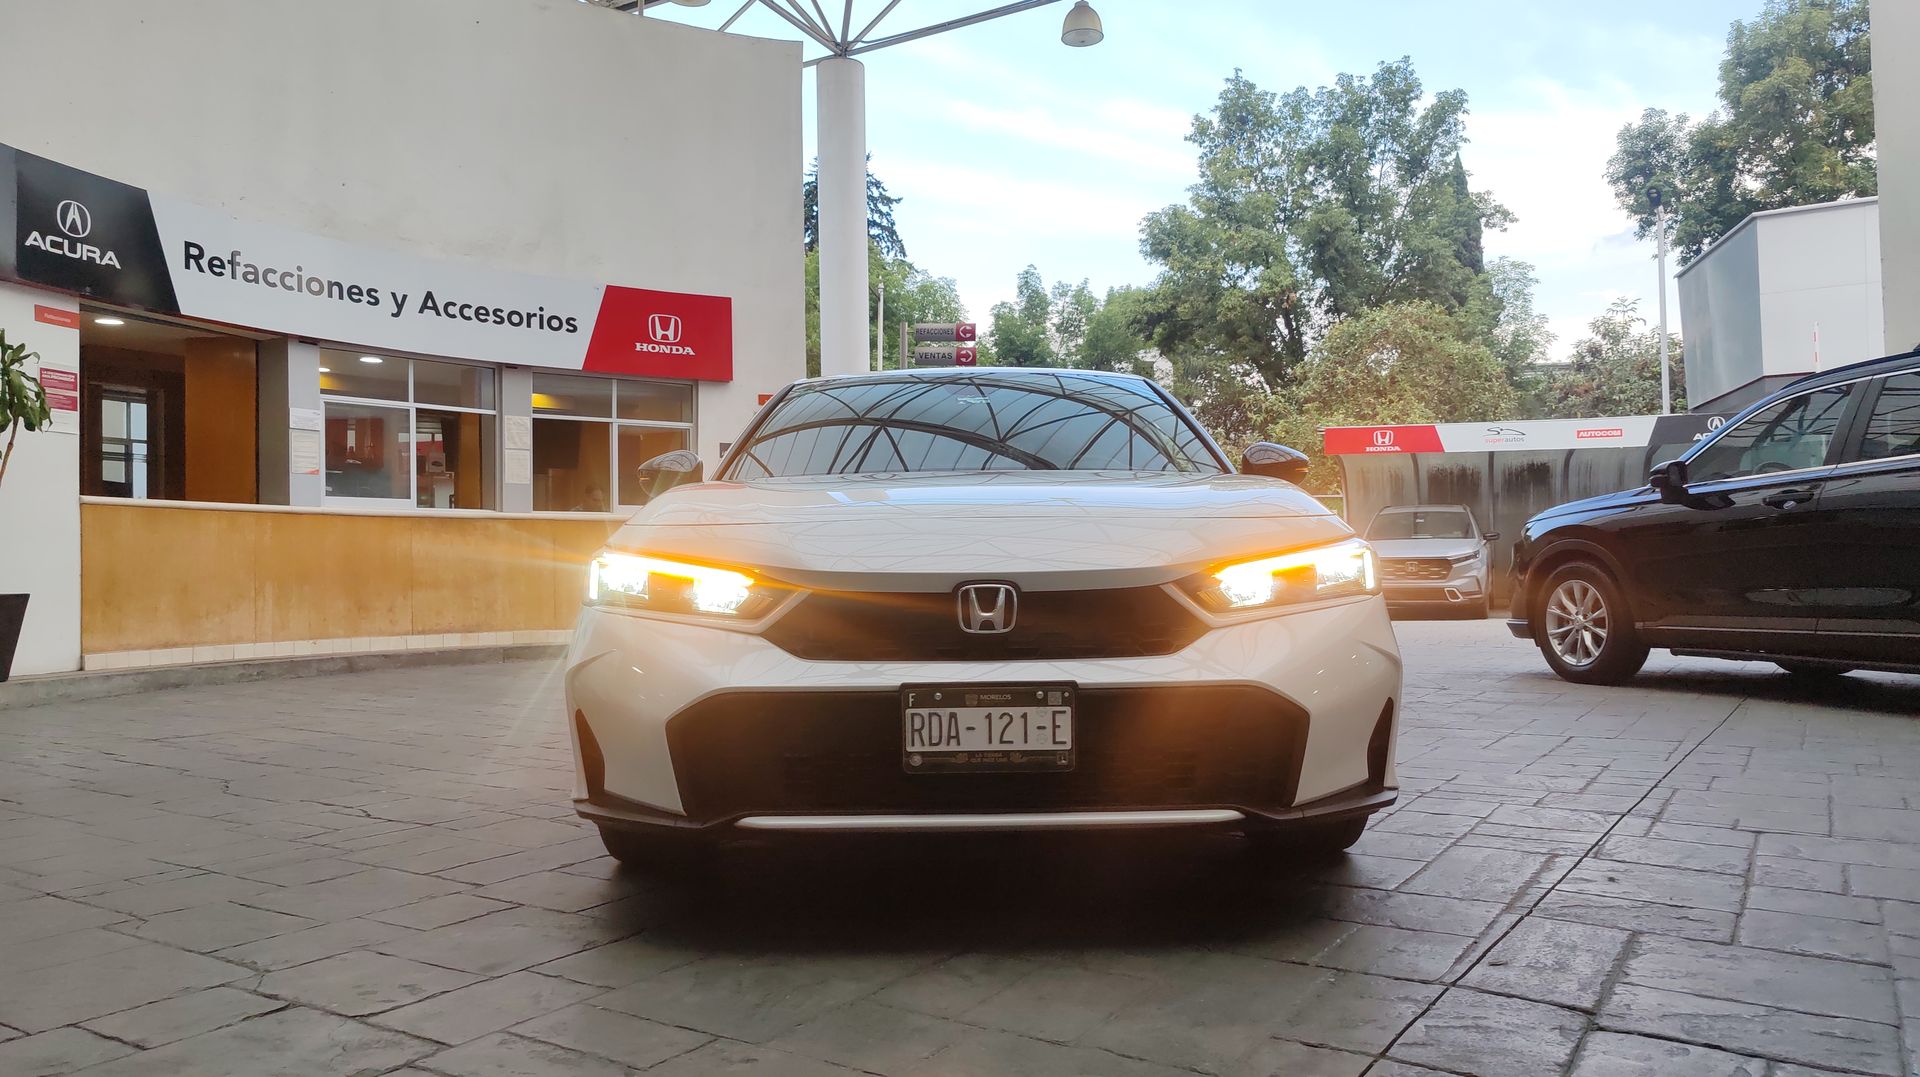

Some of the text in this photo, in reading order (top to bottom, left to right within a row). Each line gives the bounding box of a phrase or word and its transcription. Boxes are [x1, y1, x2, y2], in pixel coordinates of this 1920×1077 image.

[24, 230, 122, 270] ACURA
[183, 239, 579, 334] Refacciones y Accesorios
[915, 327, 954, 335] REFACCIONES
[634, 342, 696, 356] HONDA
[918, 352, 953, 360] VENTAS
[908, 693, 916, 708] F
[909, 710, 1068, 747] RDA-121-E
